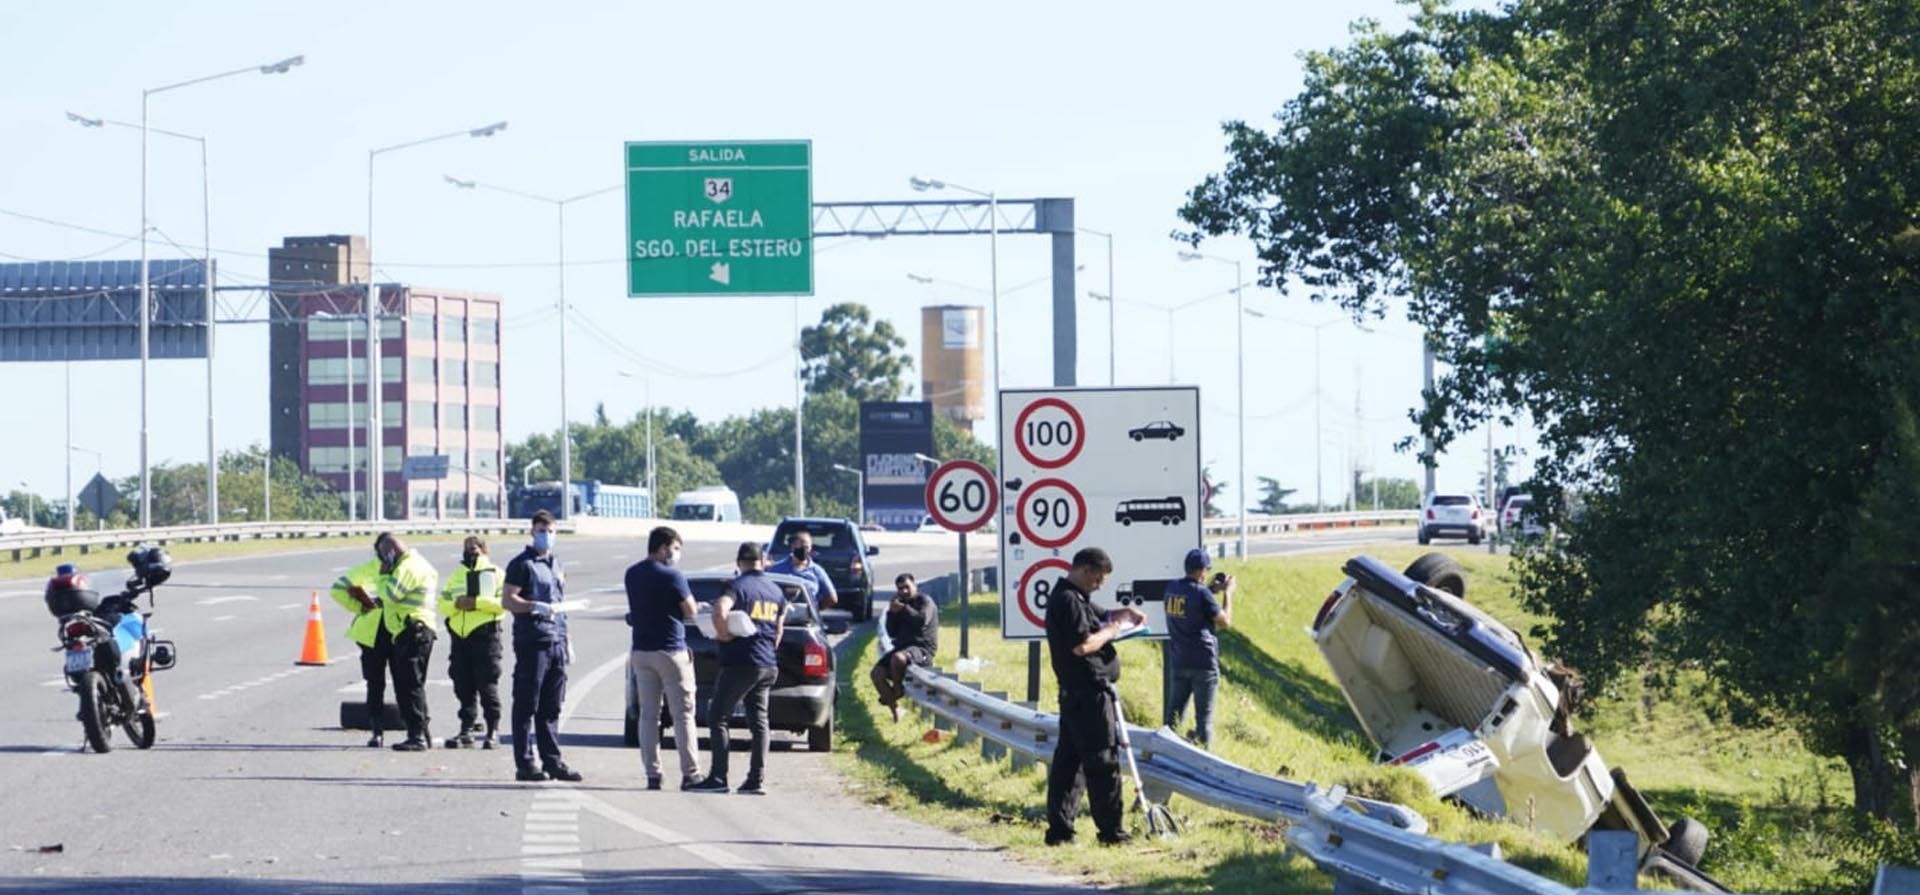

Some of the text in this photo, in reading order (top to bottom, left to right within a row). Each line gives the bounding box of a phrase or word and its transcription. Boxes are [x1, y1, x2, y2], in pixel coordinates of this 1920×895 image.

[688, 148, 746, 162] SALIDA
[707, 180, 730, 198] 34
[673, 209, 764, 228] RAFAELA
[635, 238, 802, 257] SGO. DEL ESTERO
[1026, 420, 1073, 447] 100
[938, 479, 986, 513] 60
[1032, 497, 1071, 528] 90
[1034, 579, 1050, 609] 8
